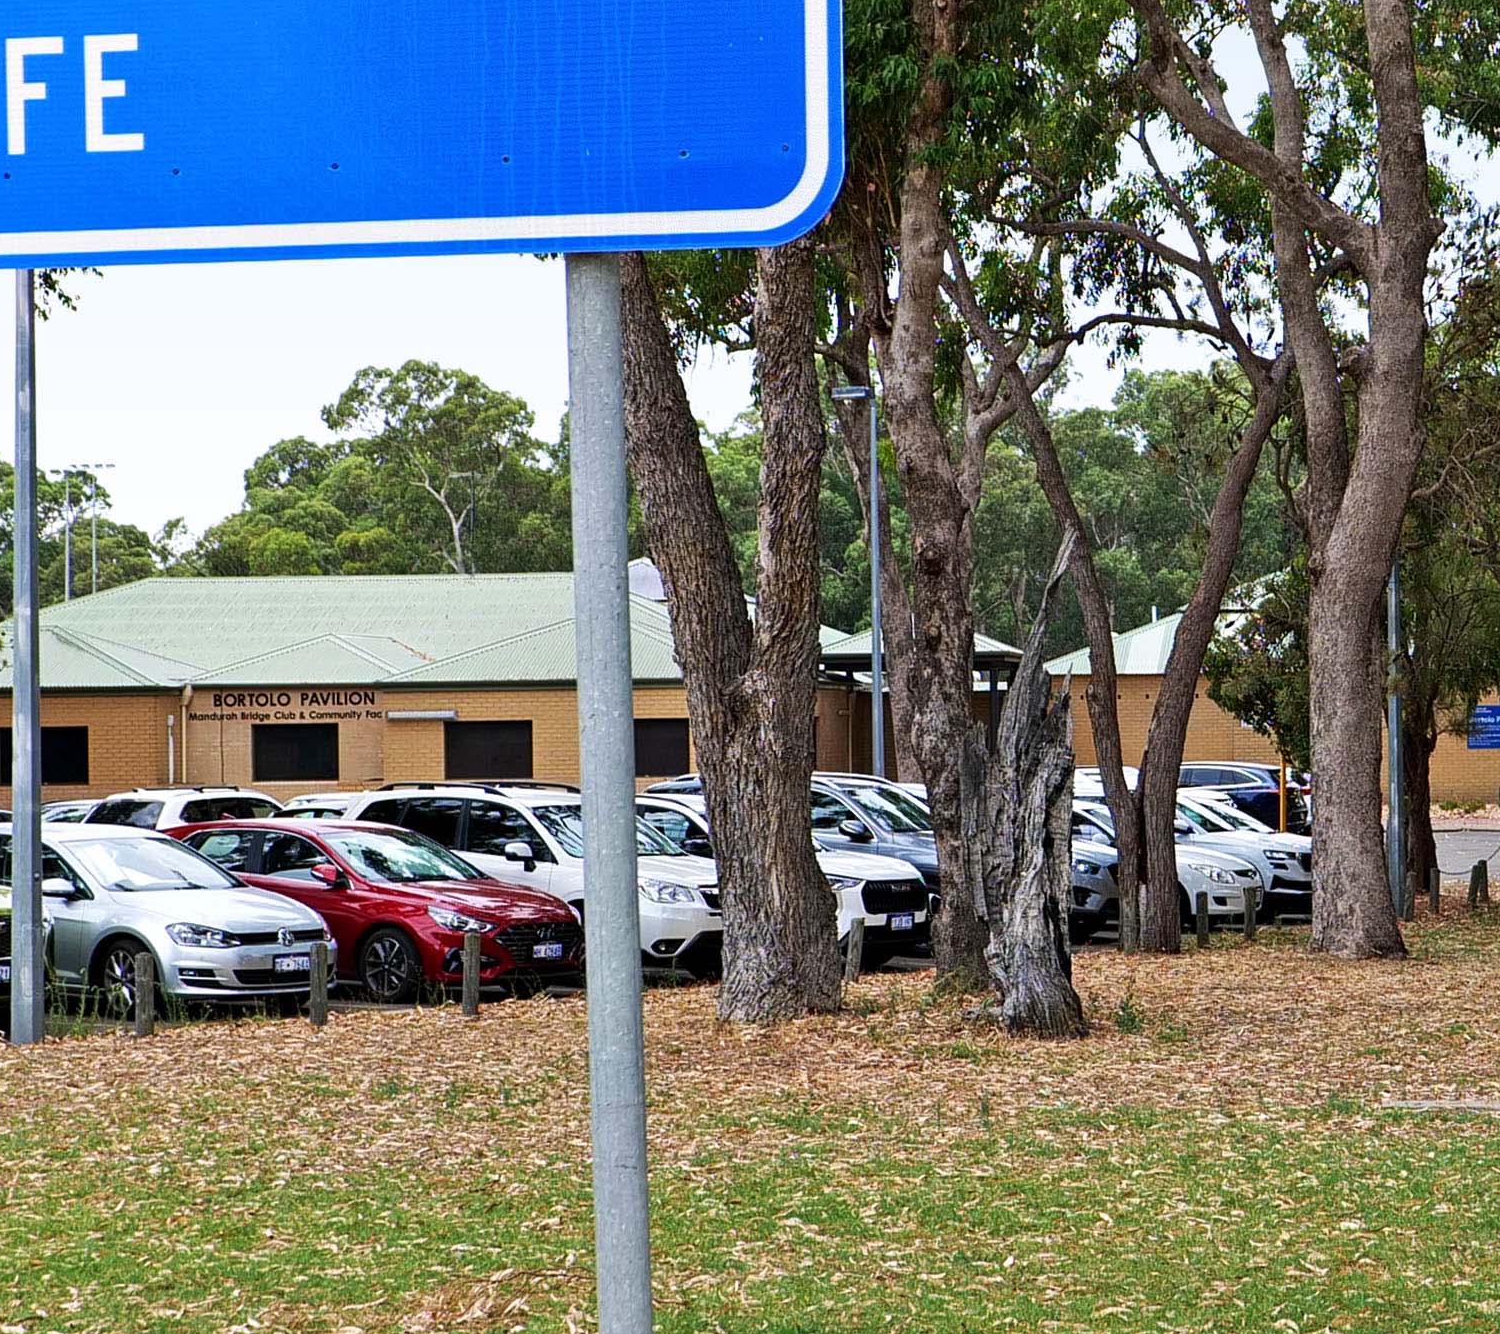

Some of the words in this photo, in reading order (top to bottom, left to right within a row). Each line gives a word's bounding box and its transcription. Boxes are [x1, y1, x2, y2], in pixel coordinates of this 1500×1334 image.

[213, 692, 291, 707] BORTOLO
[300, 691, 375, 706] PAVILION
[188, 712, 238, 722] Mandurah
[241, 711, 271, 722] Bridge
[274, 711, 296, 720] Club
[300, 711, 306, 719] &
[309, 710, 362, 721] Community
